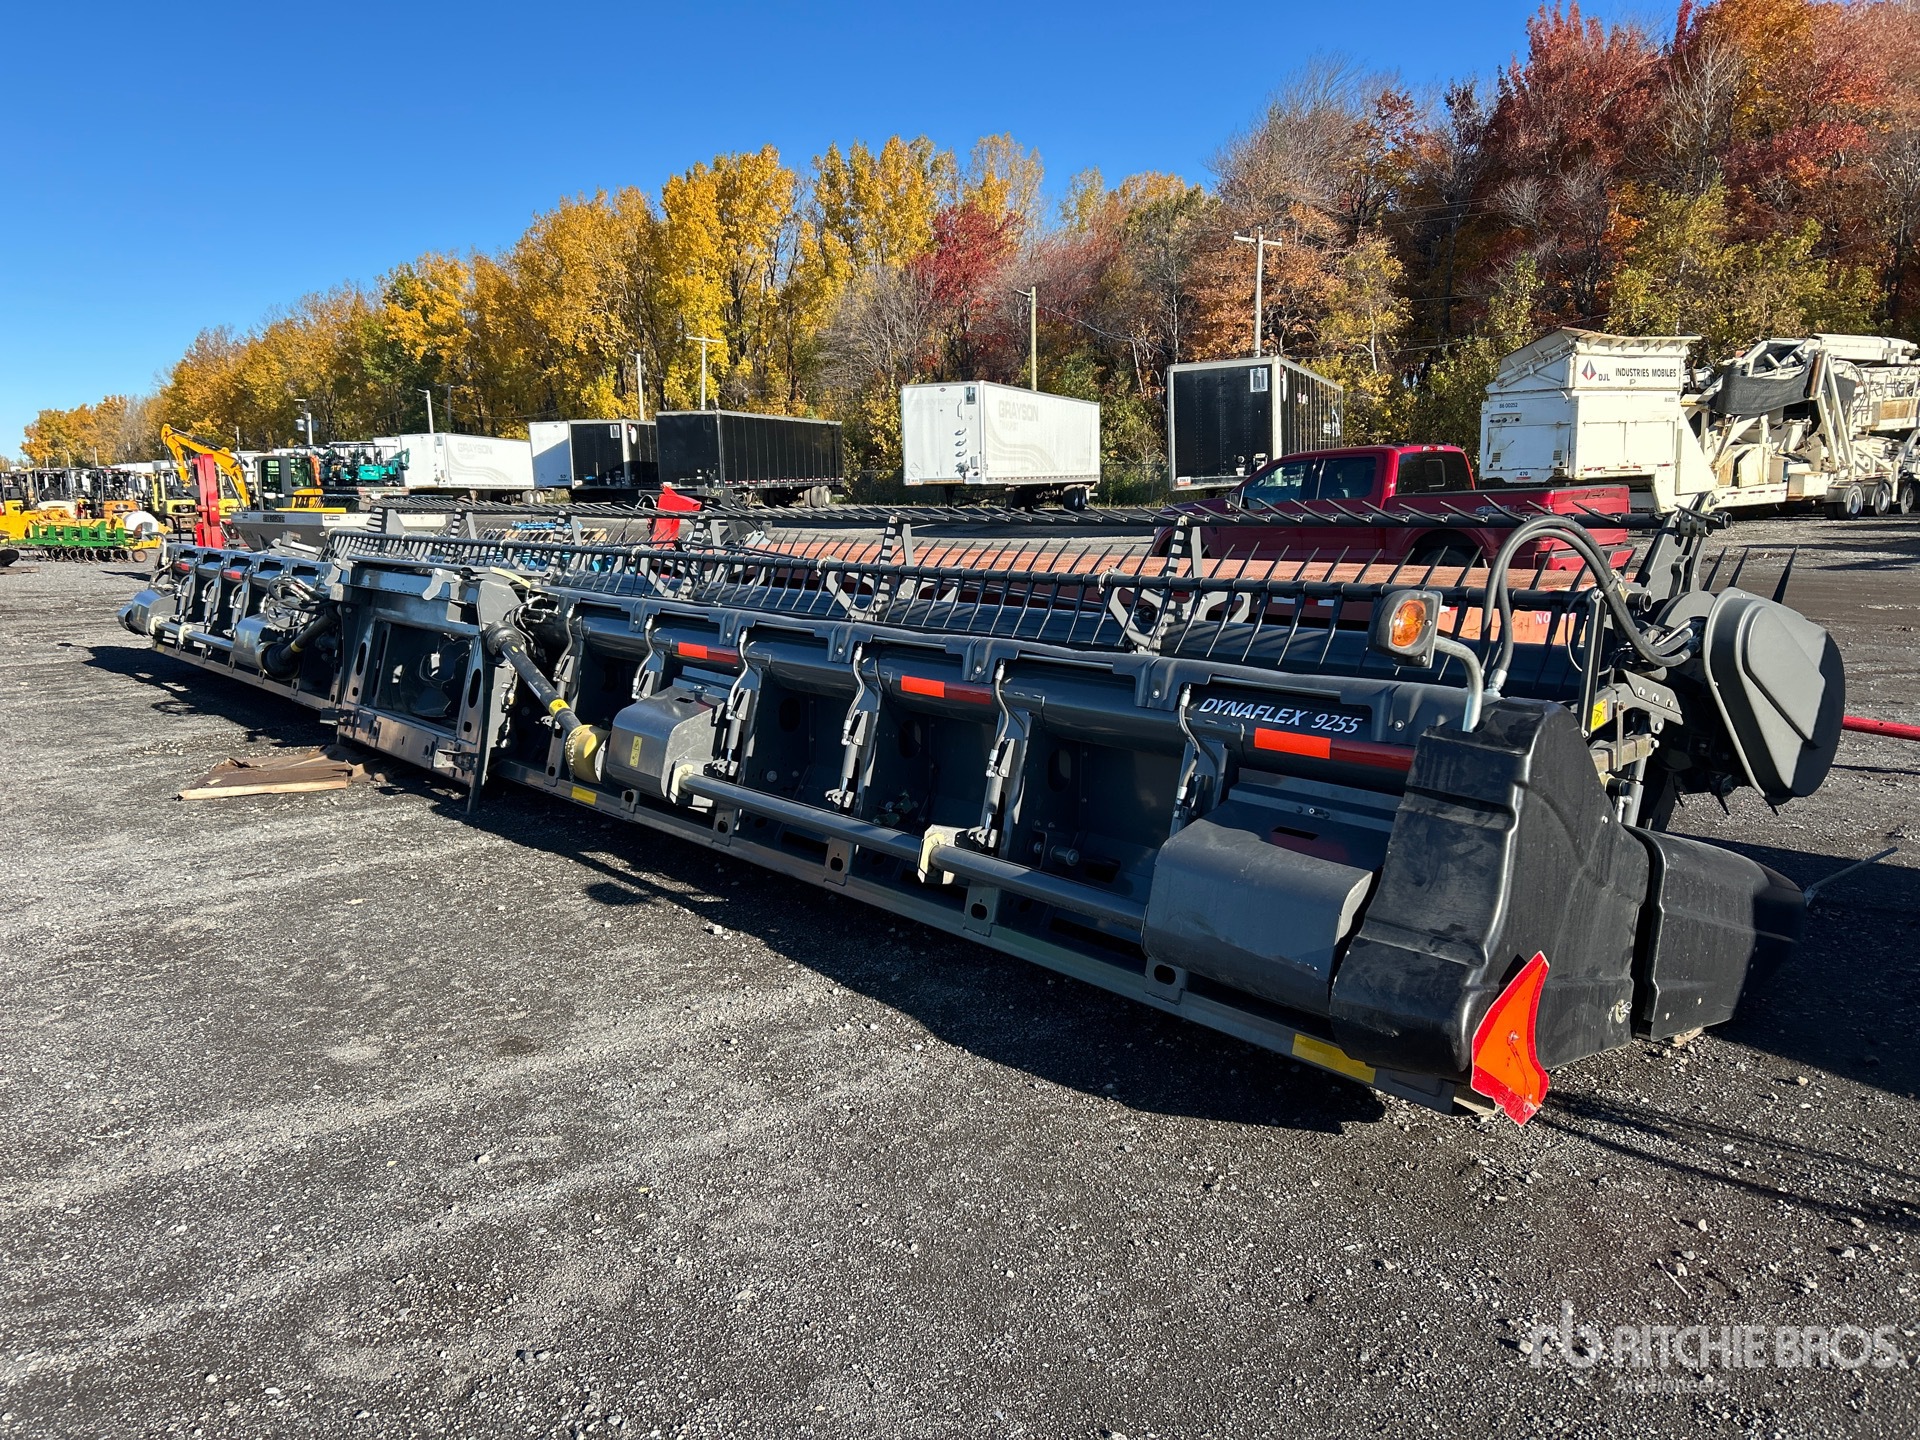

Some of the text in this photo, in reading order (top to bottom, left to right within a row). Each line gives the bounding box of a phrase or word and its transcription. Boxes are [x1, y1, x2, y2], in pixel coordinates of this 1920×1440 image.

[1598, 373, 1611, 381] DJL
[1615, 367, 1677, 377] INDUSTRIES MOBILES
[999, 400, 1039, 422] GRAYSON
[1198, 697, 1364, 735] DYNAFLEX 9255
